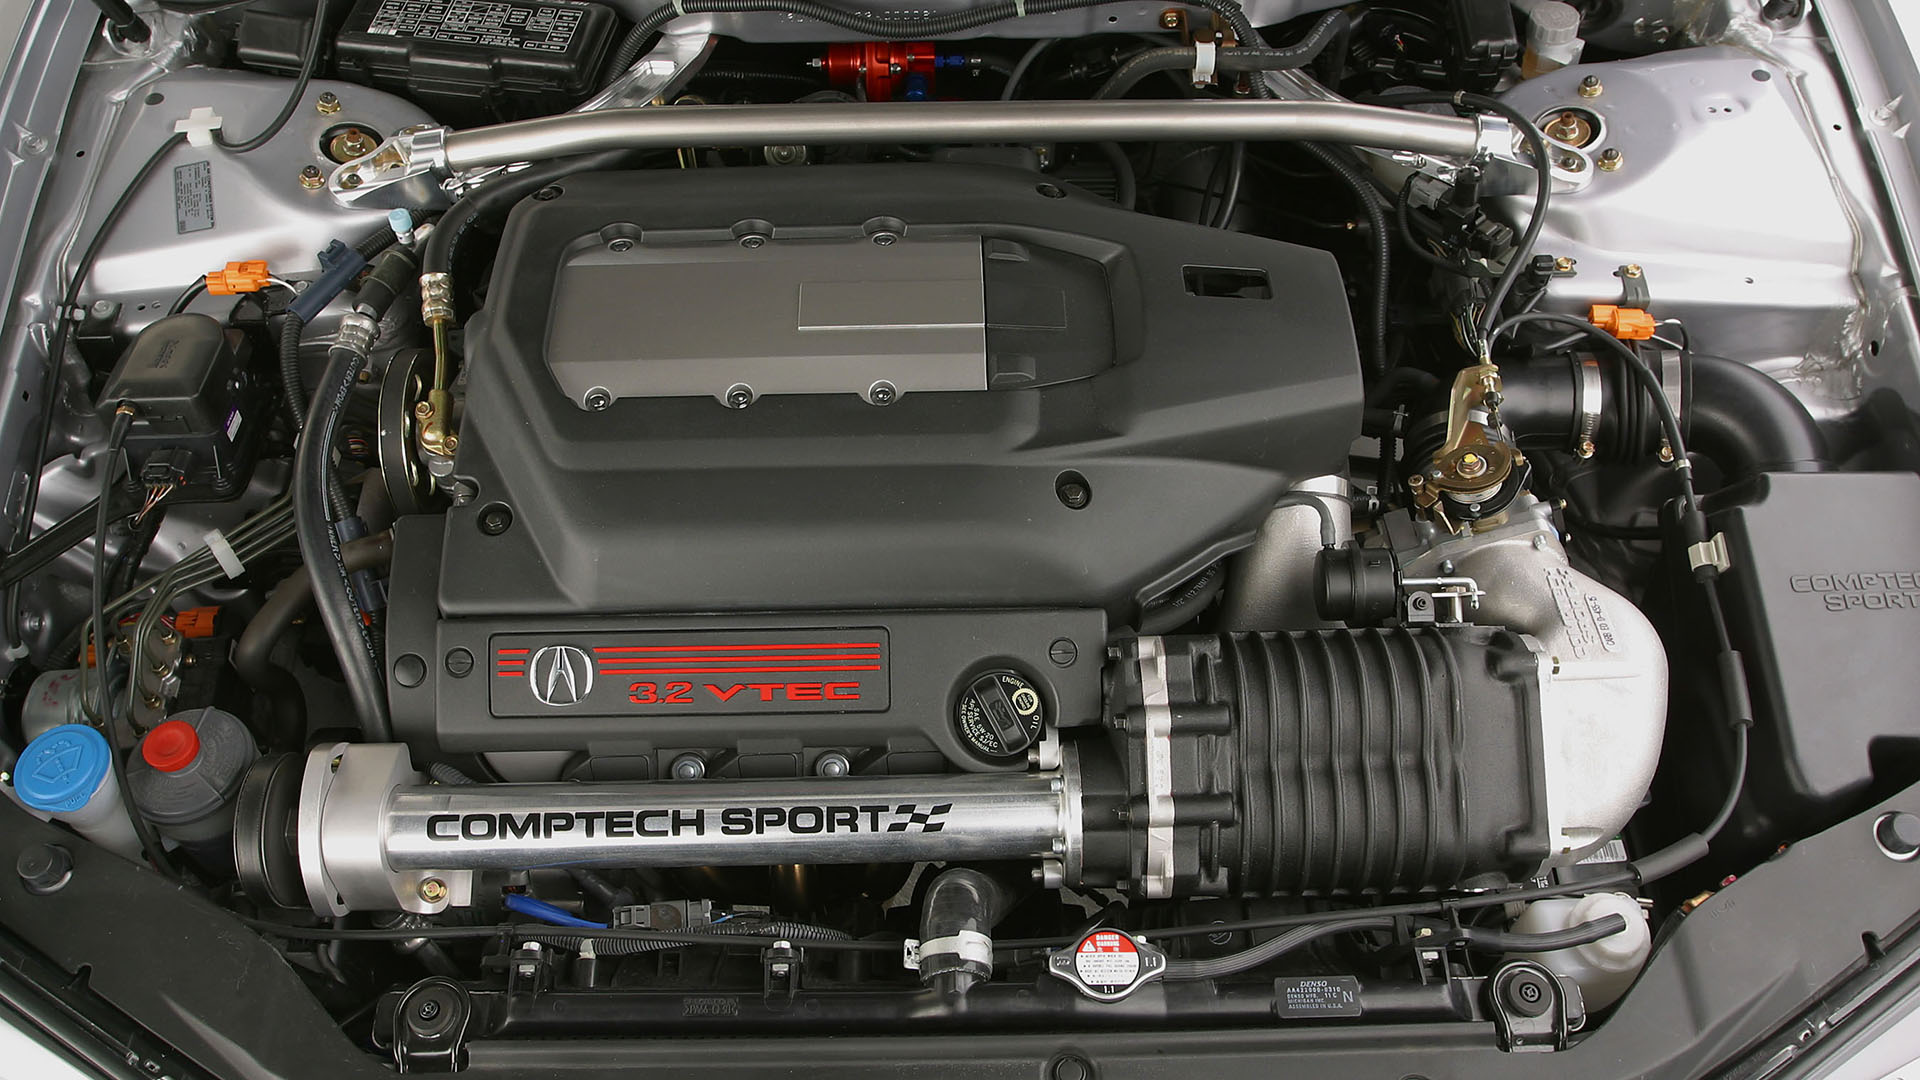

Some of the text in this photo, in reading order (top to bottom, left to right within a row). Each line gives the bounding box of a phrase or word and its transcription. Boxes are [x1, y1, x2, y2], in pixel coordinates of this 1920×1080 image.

[629, 681, 861, 703] 3.2 VTEC
[1002, 675, 1040, 730] ENGINE OIL
[967, 711, 981, 738] SERVICE
[427, 805, 891, 842] COMPTECH SPORT
[1145, 956, 1157, 967] 1.1
[1104, 985, 1115, 994] 1.1
[1300, 980, 1328, 988] DENSO
[1342, 990, 1354, 1003] N
